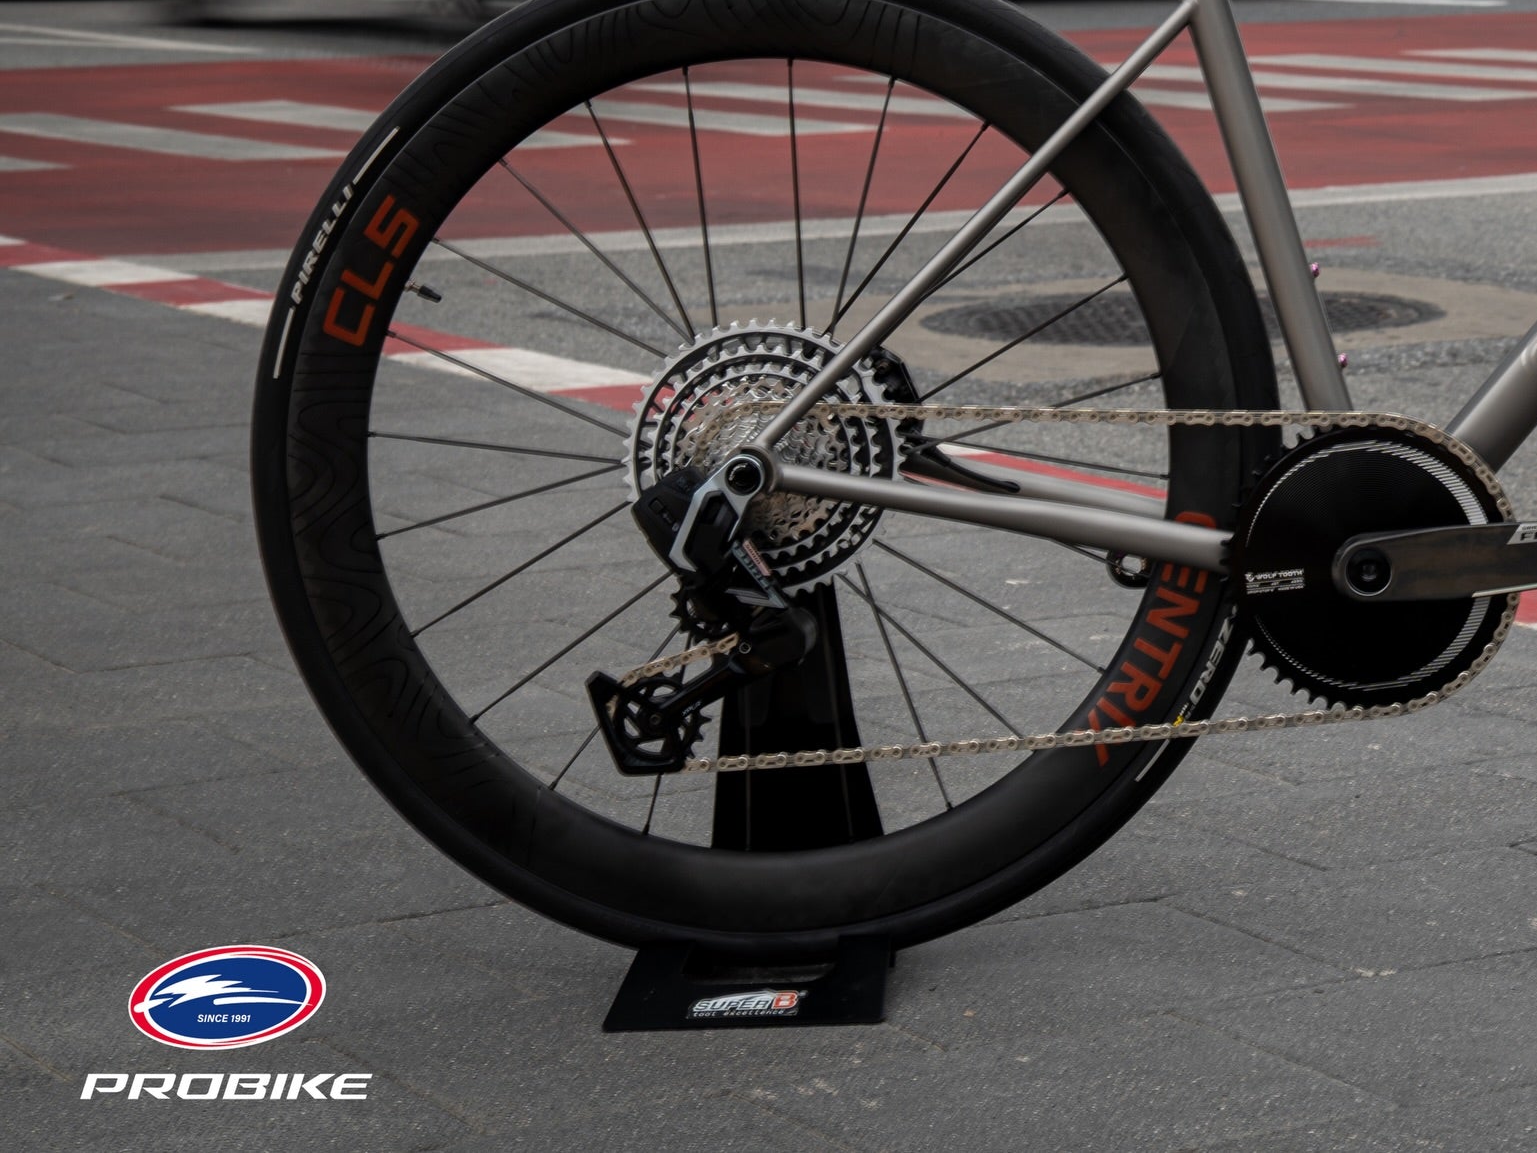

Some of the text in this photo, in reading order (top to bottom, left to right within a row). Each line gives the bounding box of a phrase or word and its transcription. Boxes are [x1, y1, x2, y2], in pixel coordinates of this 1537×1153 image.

[291, 183, 354, 305] PIRELLI
[322, 194, 420, 347] CLS
[1254, 568, 1304, 581] WOLF TOOTH
[723, 1009, 785, 1017] excellence
